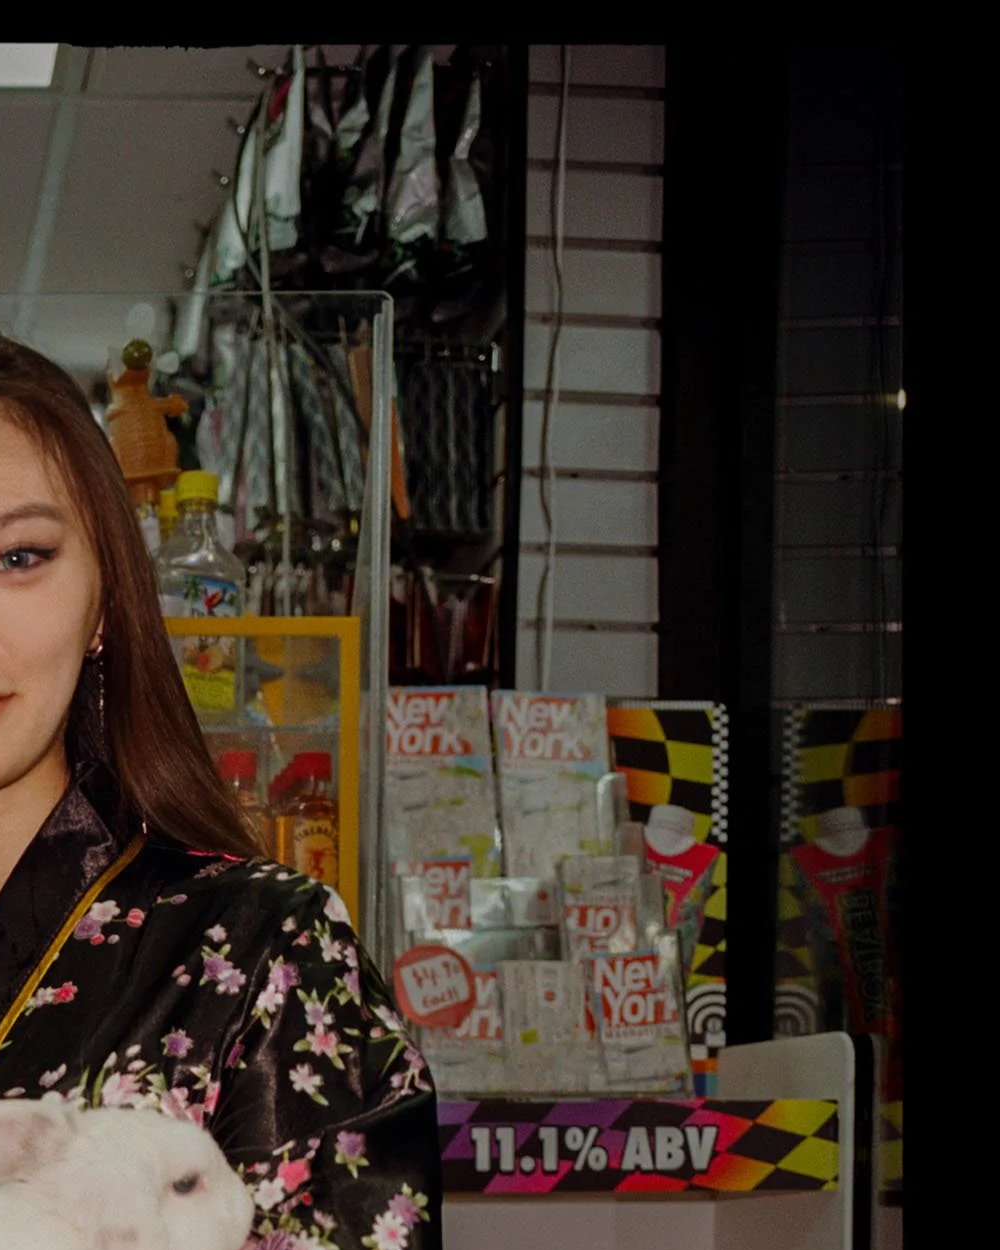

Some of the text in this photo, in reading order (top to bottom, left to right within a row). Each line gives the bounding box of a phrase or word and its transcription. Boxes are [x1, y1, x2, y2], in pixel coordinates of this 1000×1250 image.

[504, 724, 586, 759] York
[470, 1126, 718, 1173] 11.1% ABV
